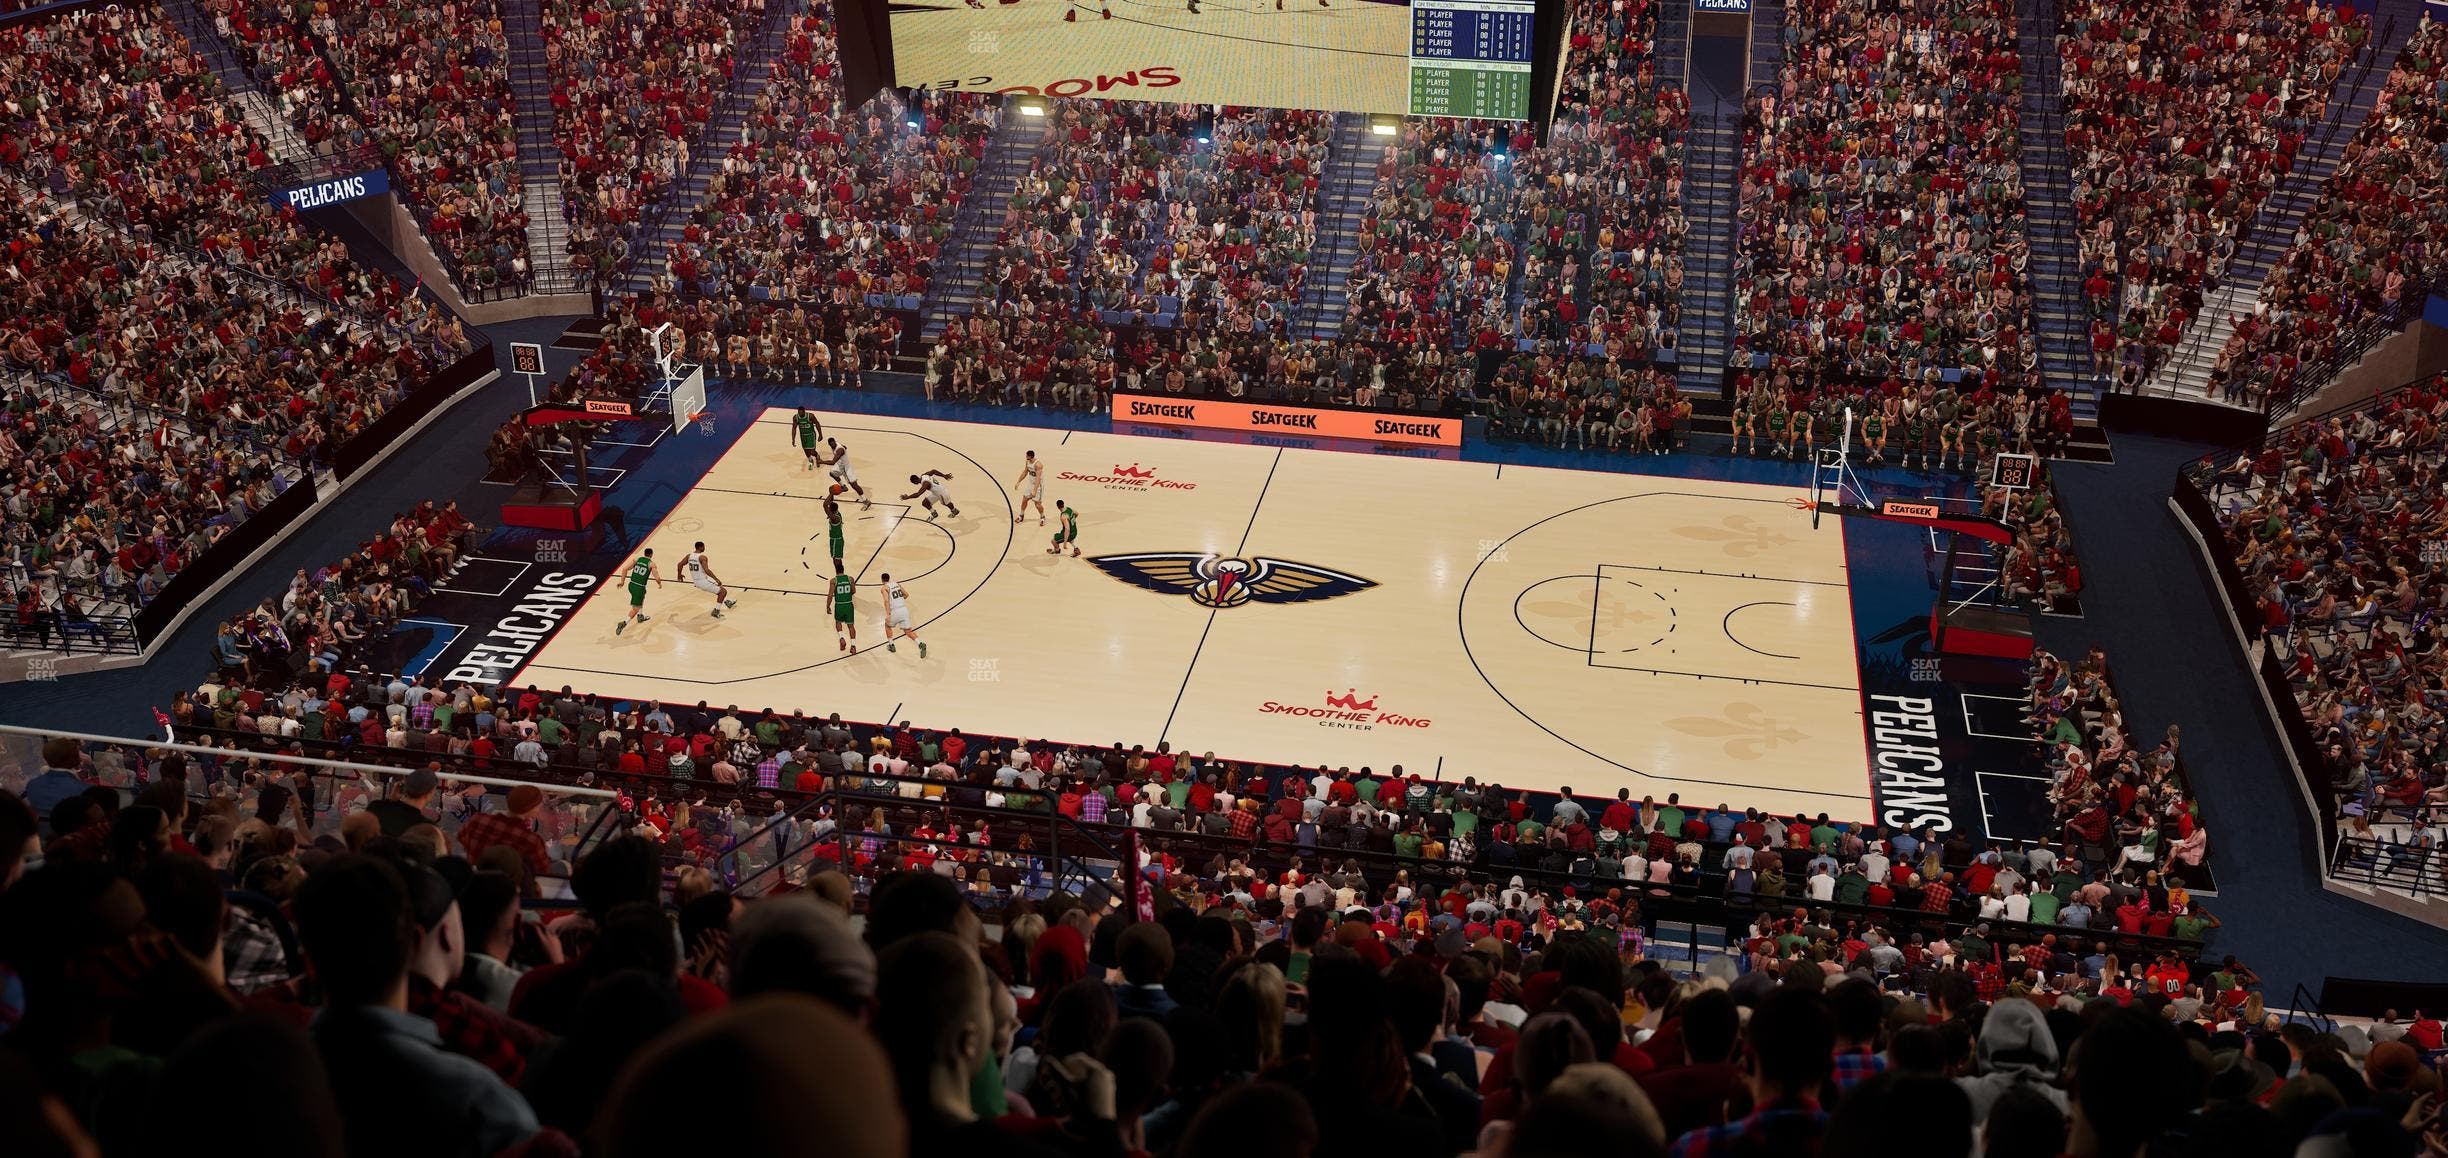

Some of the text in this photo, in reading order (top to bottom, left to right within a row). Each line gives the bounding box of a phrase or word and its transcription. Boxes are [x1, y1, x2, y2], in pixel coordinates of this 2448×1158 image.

[288, 177, 365, 209] PELICANS
[589, 402, 627, 413] SEATGEEK
[1131, 401, 1195, 420] SEATGEEK
[1252, 410, 1317, 429] SEATGEEK
[1375, 420, 1441, 438] SEATGEEK
[1057, 472, 1148, 486] SMOOTHIE
[1890, 505, 1932, 516] SEATGEEK
[443, 572, 597, 684] PELICANS
[1258, 702, 1371, 722] SMOOTHIE
[1319, 721, 1372, 731] CENTER
[1871, 694, 1953, 832] PELICANS
[2166, 979, 2180, 992] 00
